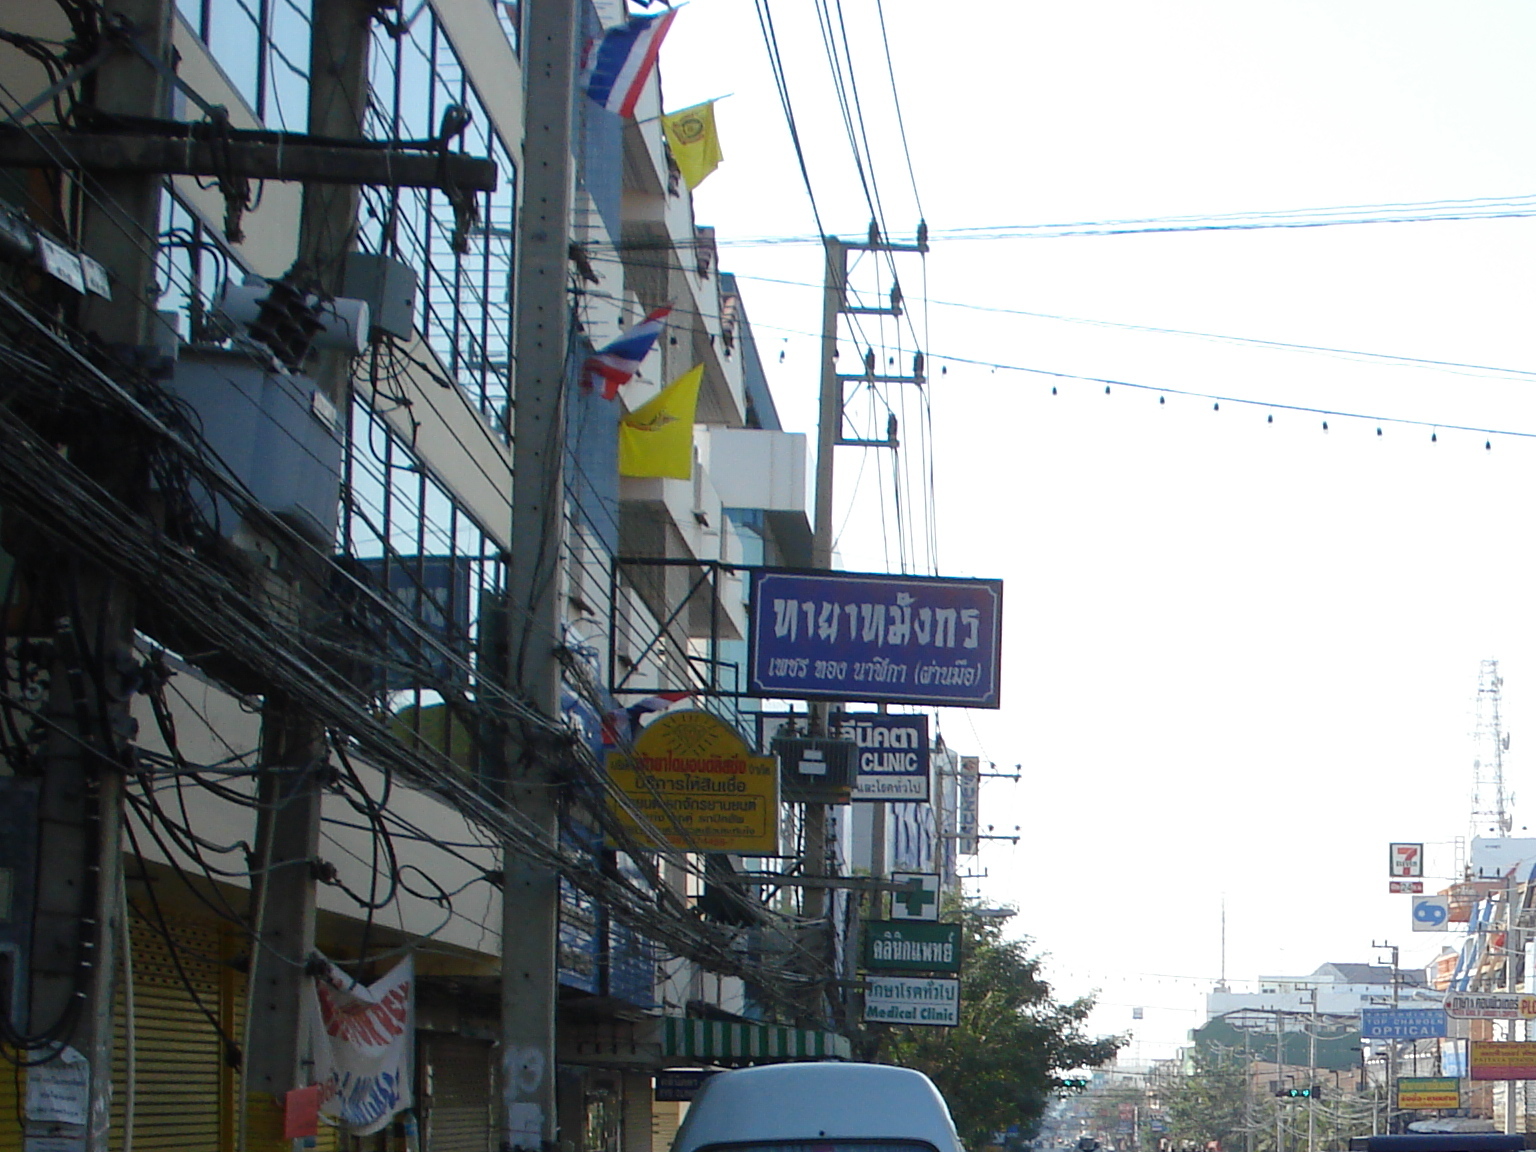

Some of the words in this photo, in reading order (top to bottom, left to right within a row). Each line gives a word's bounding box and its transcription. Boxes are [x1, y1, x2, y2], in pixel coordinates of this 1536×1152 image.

[814, 659, 847, 680] ทอง
[861, 752, 918, 772] CLINIC
[873, 931, 955, 963] คลินิกแพทย์
[866, 1005, 917, 1019] Medical
[920, 1007, 953, 1021] Clinic
[1371, 1026, 1439, 1036] OPTICAL
